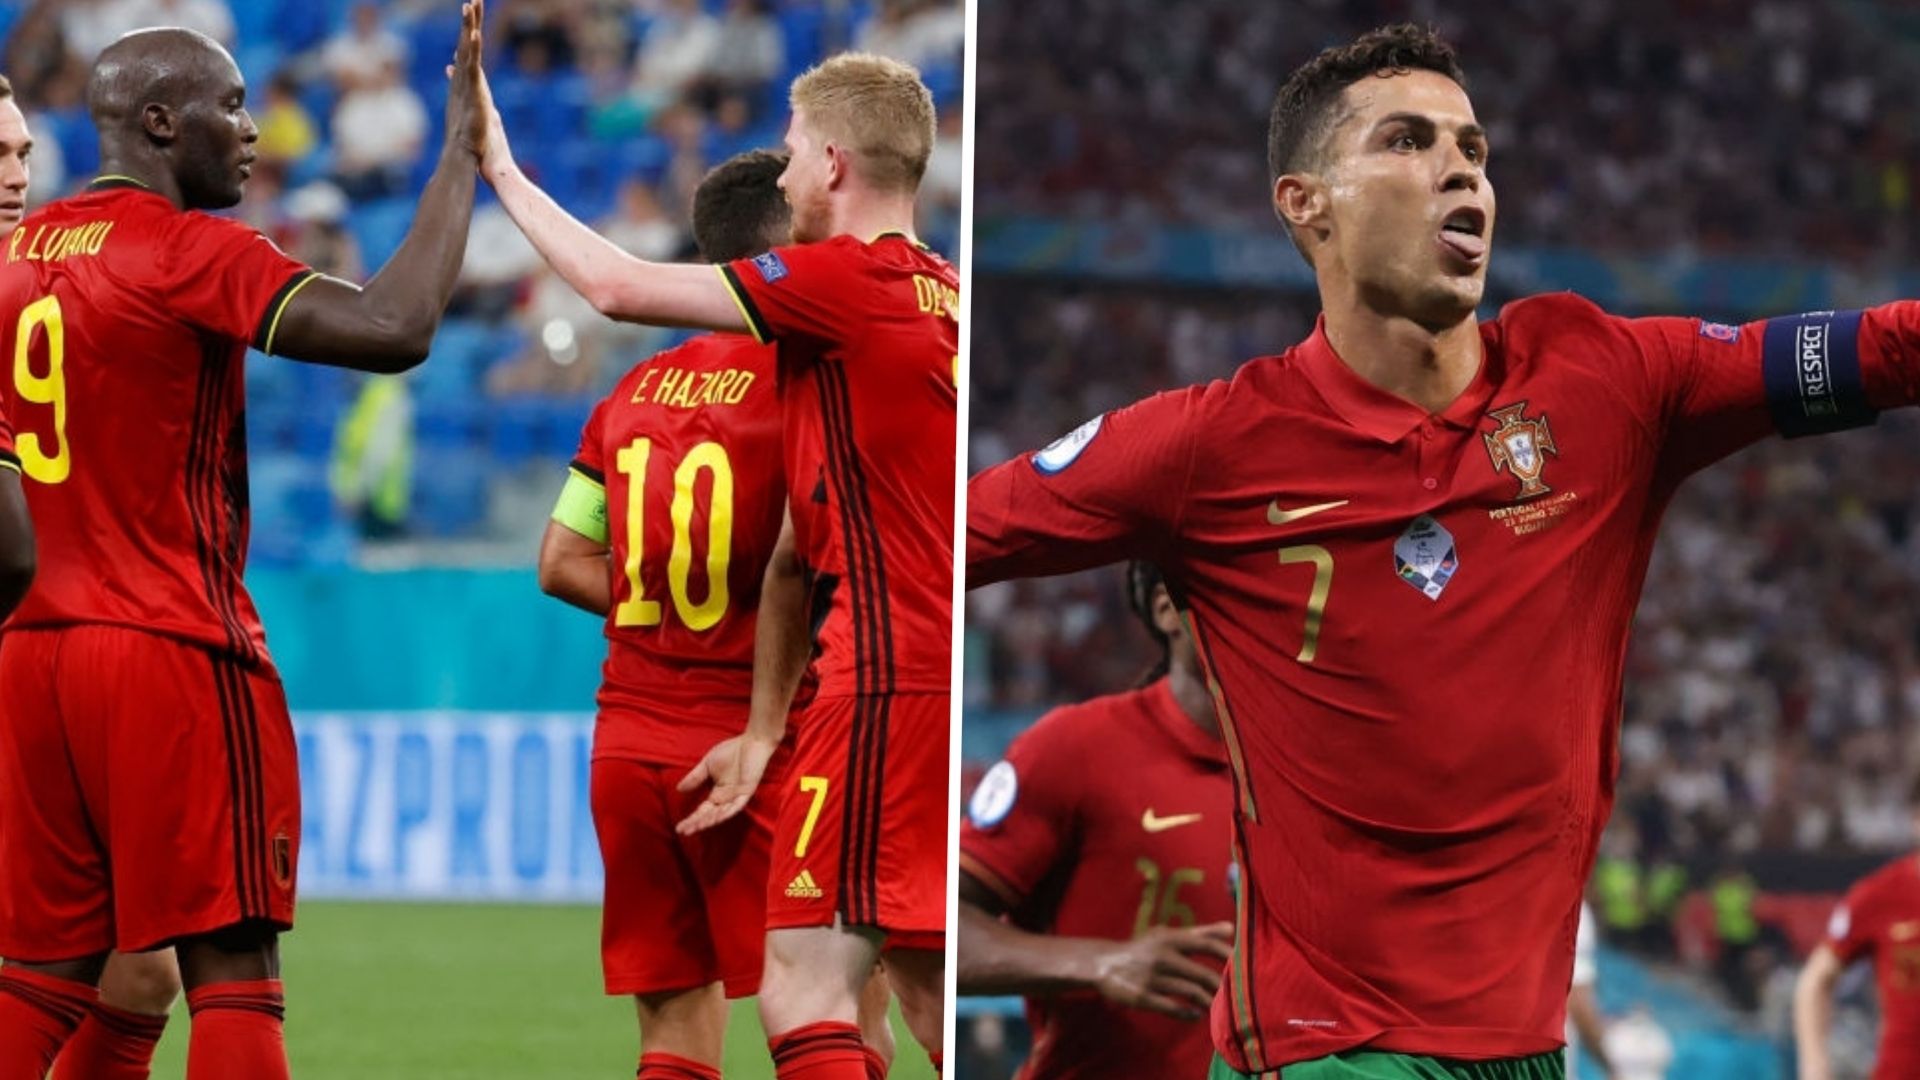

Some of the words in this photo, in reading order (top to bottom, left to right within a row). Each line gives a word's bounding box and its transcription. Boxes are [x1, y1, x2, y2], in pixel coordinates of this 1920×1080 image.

[14, 295, 70, 484] 9
[653, 367, 755, 408] HAZARD
[1803, 324, 1824, 396] RESPECT
[615, 437, 734, 631] 10
[1278, 544, 1334, 662] 7
[794, 776, 829, 858] 7
